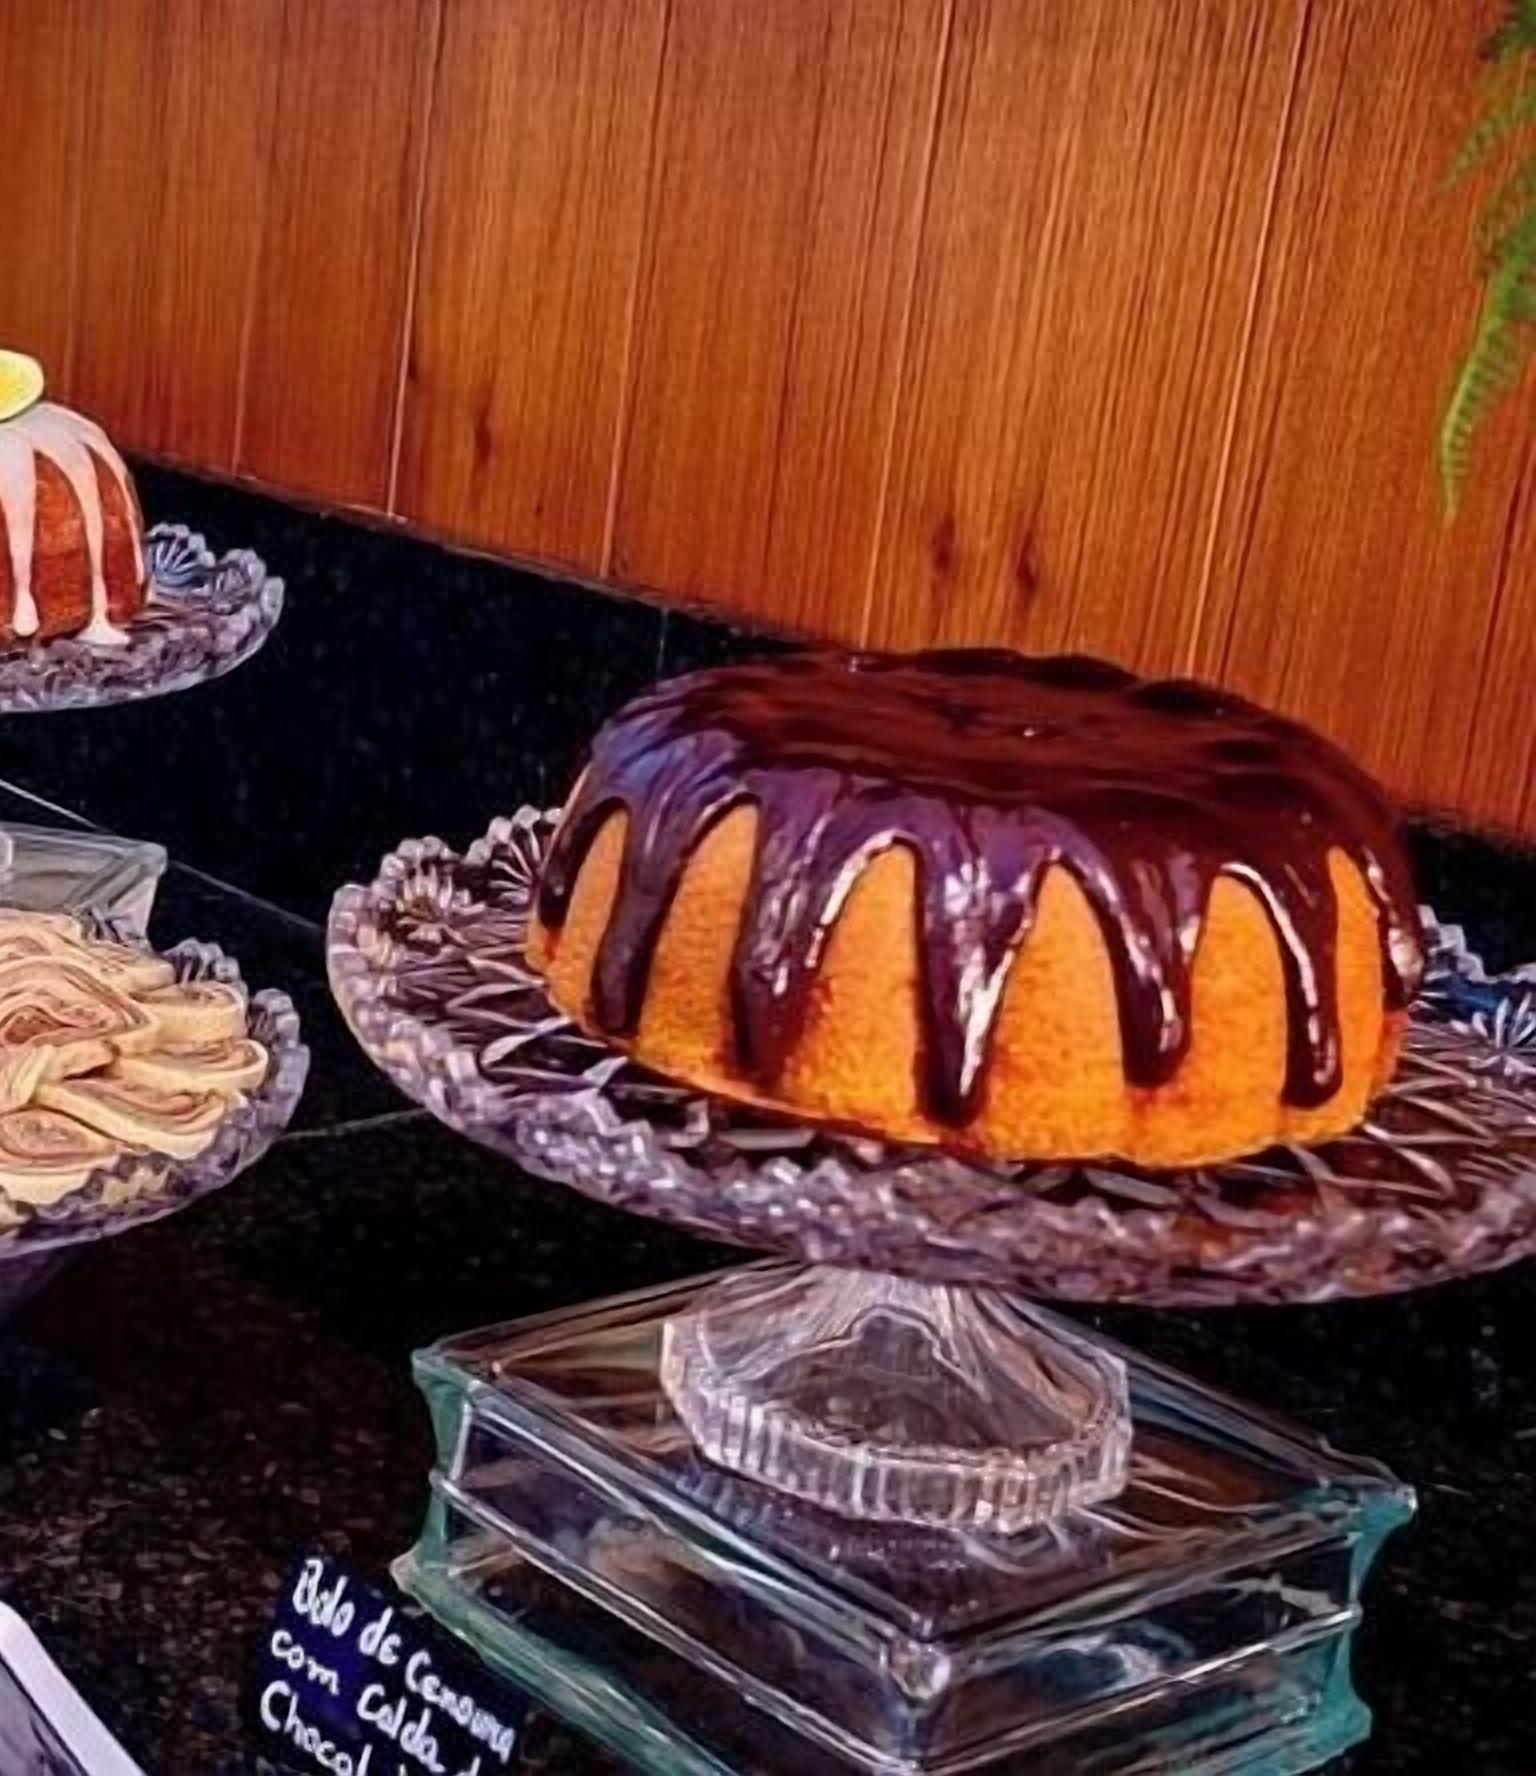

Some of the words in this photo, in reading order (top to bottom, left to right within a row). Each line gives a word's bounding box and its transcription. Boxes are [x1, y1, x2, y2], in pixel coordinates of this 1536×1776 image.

[292, 1558, 356, 1637] Bolo
[359, 1606, 402, 1665] de
[271, 1630, 340, 1695] com
